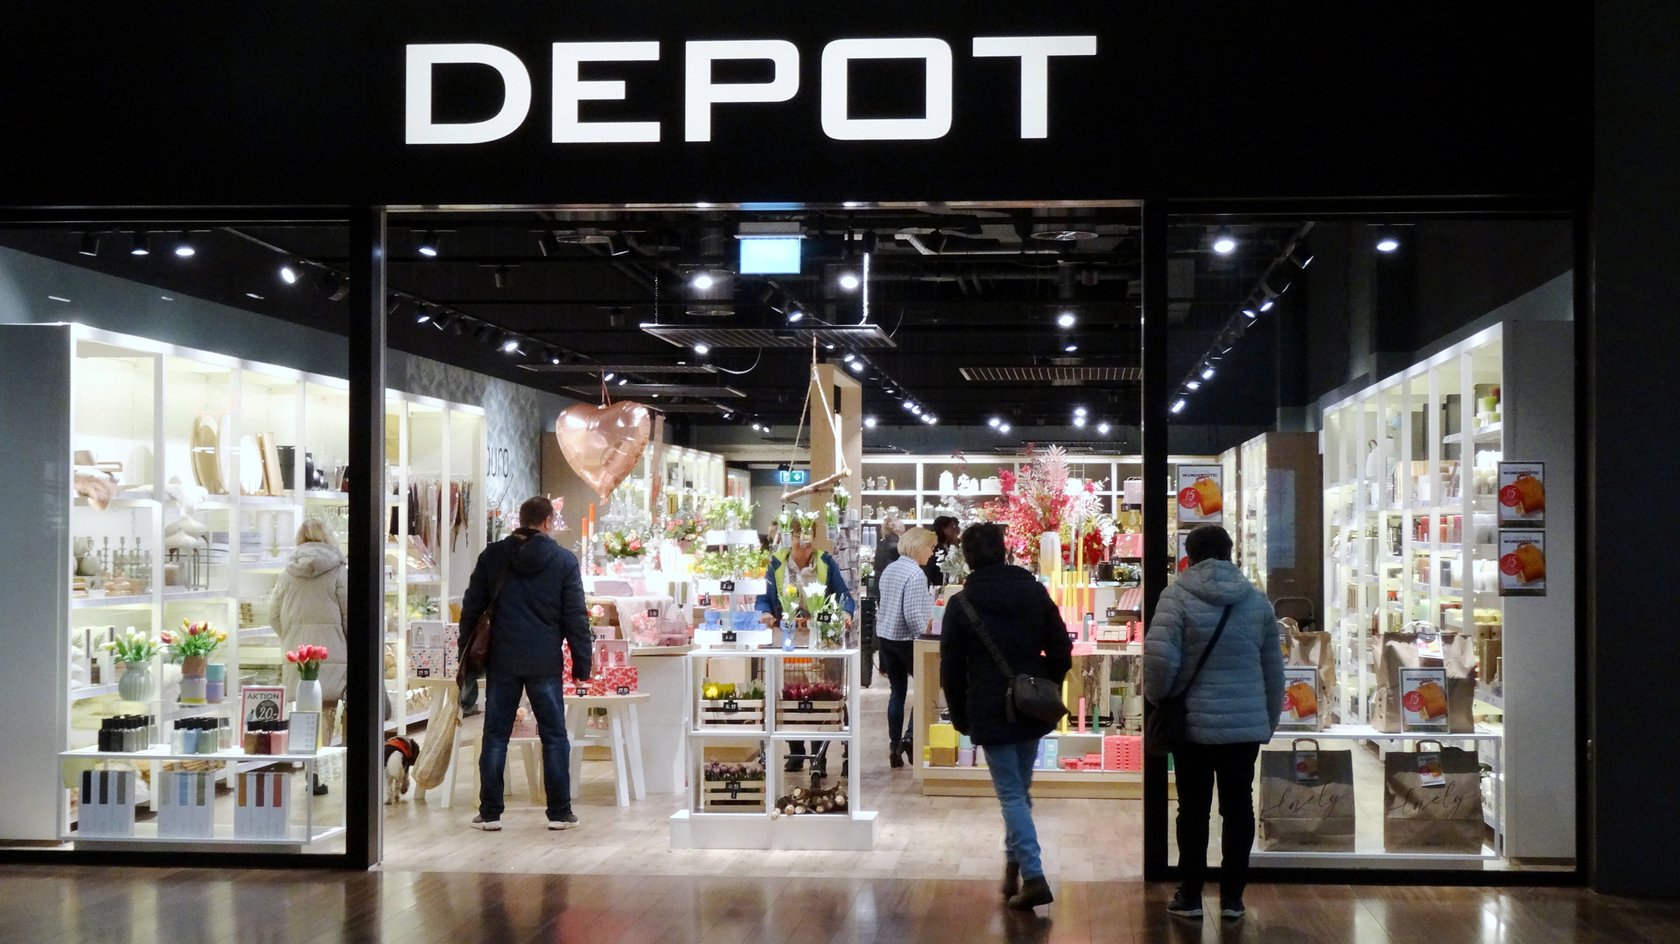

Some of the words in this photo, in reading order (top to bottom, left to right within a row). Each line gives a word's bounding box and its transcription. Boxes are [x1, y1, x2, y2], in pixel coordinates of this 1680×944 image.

[405, 35, 1097, 145] DEPOT
[1186, 490, 1195, 501] 15
[247, 692, 279, 700] AKTION
